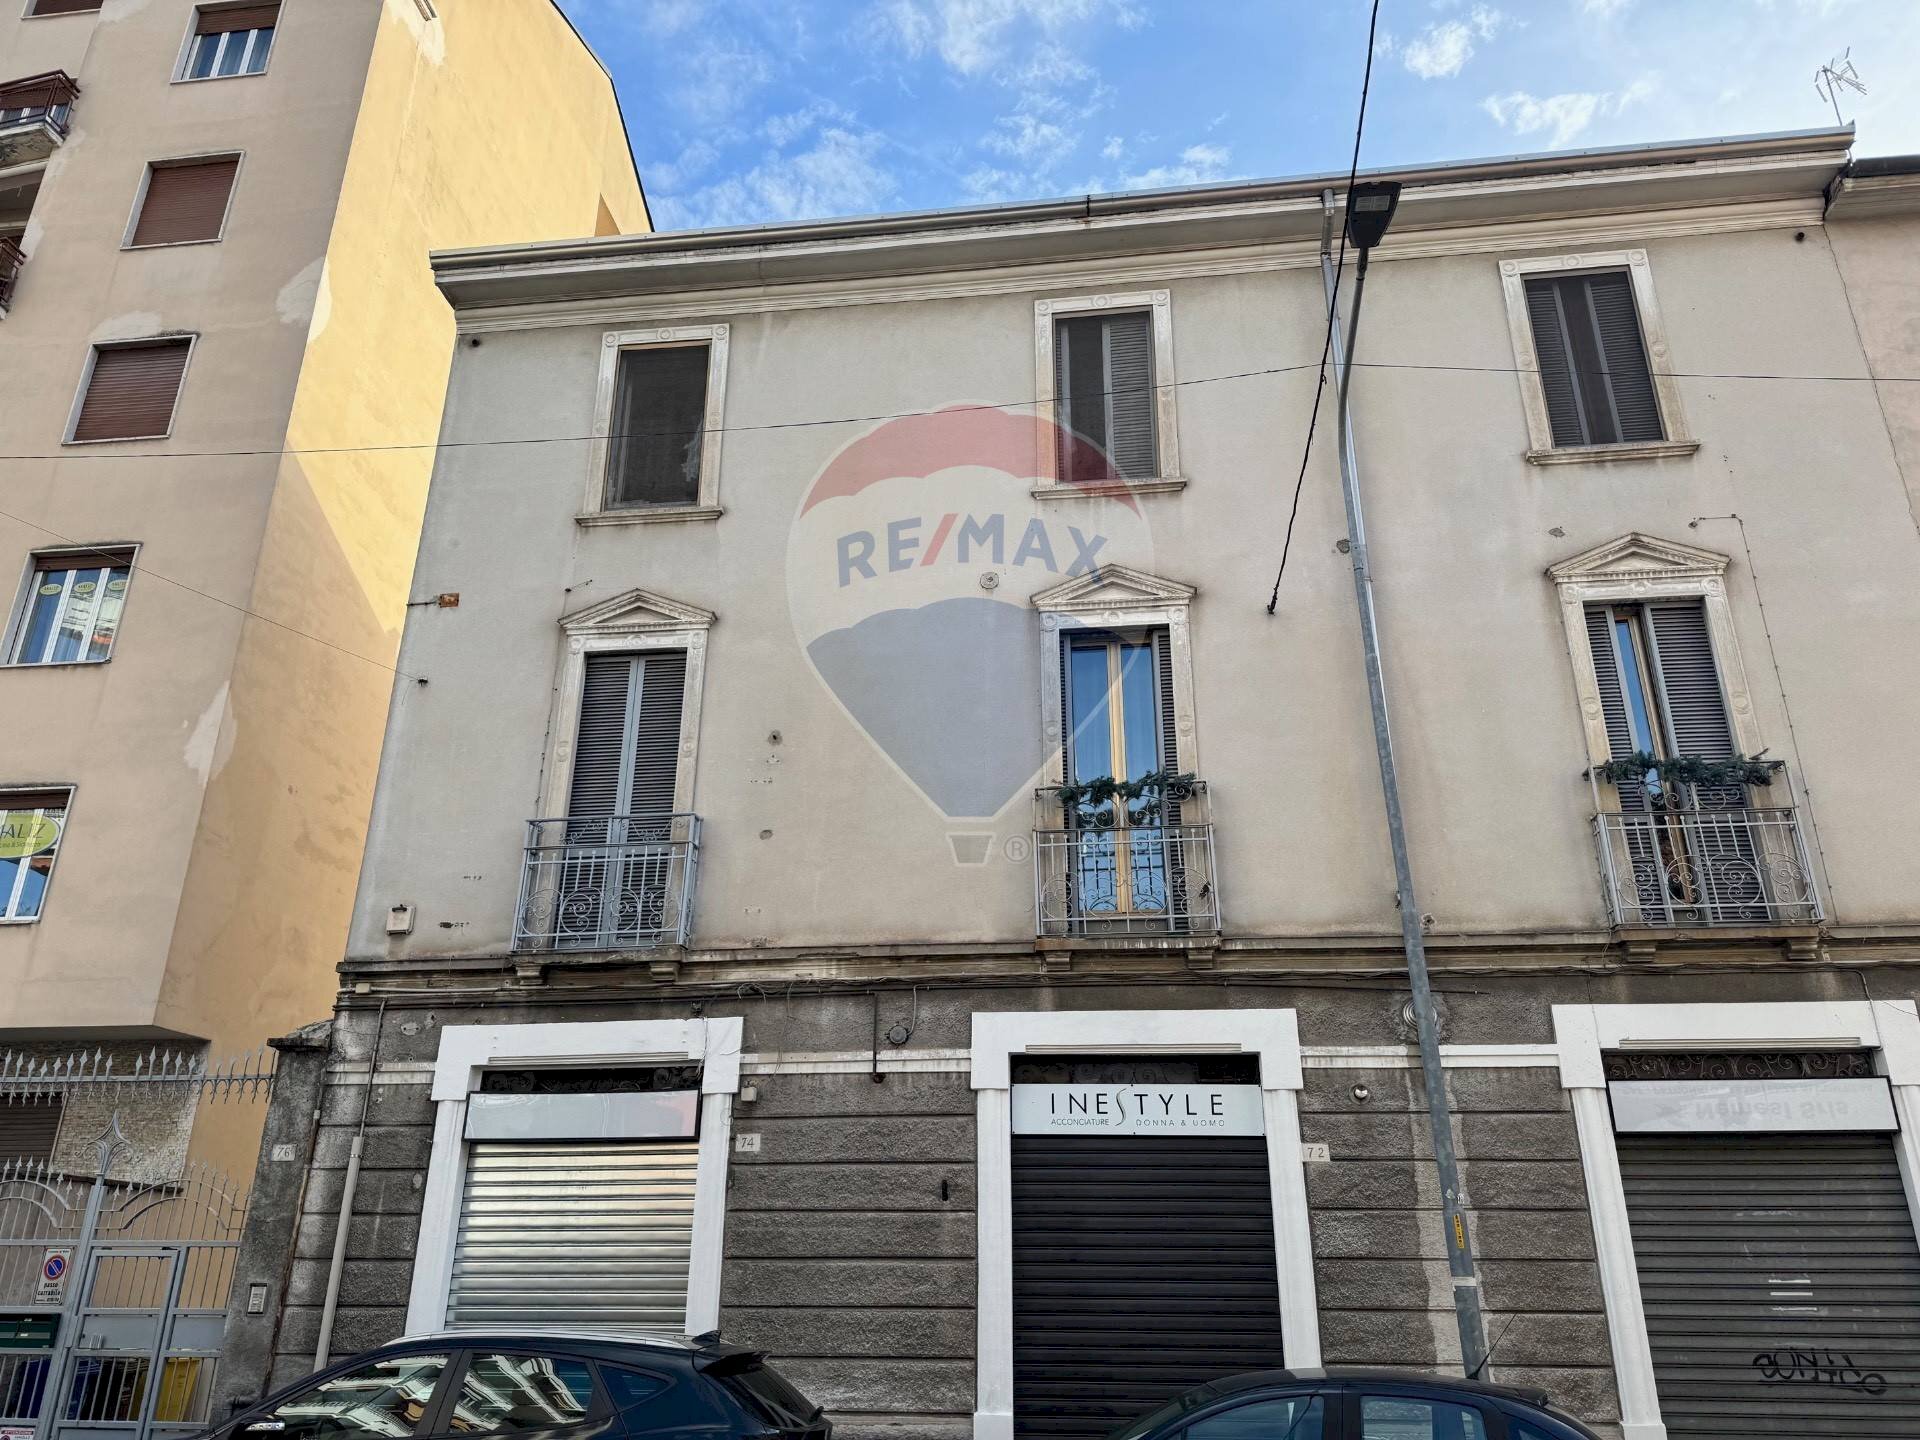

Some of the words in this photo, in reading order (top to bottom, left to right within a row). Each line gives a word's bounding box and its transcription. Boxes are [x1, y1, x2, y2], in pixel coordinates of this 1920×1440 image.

[1051, 1088, 1223, 1126] INESTYLE
[1051, 1118, 1109, 1126] ACCONCIATURE
[1136, 1119, 1175, 1127] DONNA
[1192, 1119, 1225, 1127] UOMO
[741, 1137, 755, 1149] 74
[278, 1146, 291, 1157] 76
